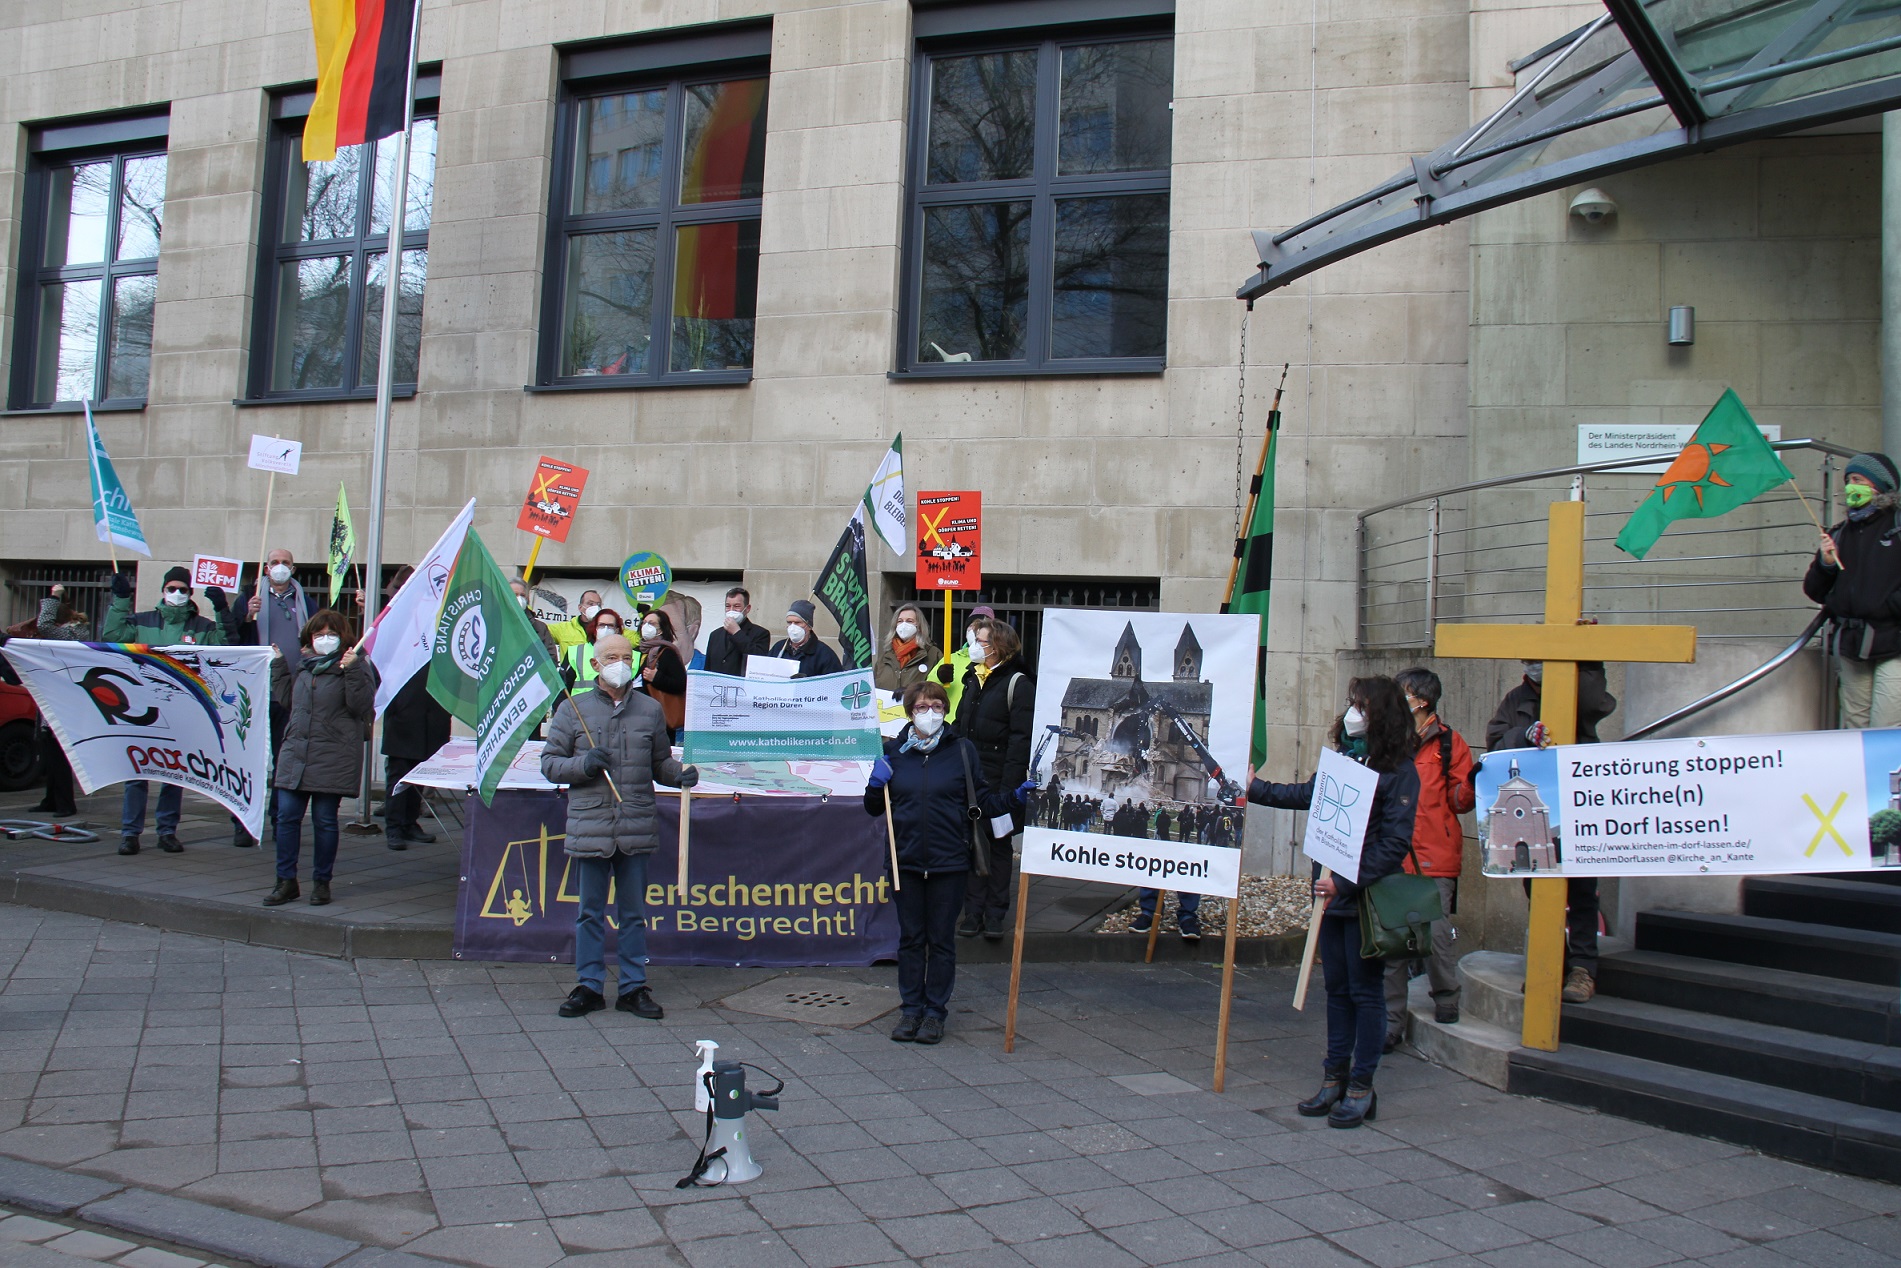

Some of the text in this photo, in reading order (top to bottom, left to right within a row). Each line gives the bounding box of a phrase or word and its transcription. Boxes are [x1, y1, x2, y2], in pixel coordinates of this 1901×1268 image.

[1605, 432, 1676, 441] Ministerpräsident
[884, 501, 906, 528] BLEIBE
[197, 572, 236, 587] SKFM
[627, 573, 665, 588] RETTEN!
[630, 567, 660, 579] KLIMA
[753, 695, 802, 703] Katholikenrat
[728, 736, 857, 746] www.katholikenrat-dn.de
[1571, 750, 1783, 777] Zerstörung stoppen!
[126, 745, 253, 805] pax christi
[142, 768, 184, 781] internationale
[185, 773, 214, 792] katholische
[1312, 771, 1327, 819] Diözesanrat
[1573, 784, 1704, 807] Die Kirche(n)
[1575, 814, 1729, 836] im Dorf lassen!
[1324, 831, 1348, 849] Katholiken
[1575, 839, 1751, 853] https://www.kirchen-im-dorf-lassen.de/
[1051, 843, 1209, 878] Kohle stoppen!
[1575, 852, 1754, 864] KirchenImDorfLassen @Kirche_an_Kante
[607, 873, 890, 906] enschenrecht
[677, 908, 856, 941] Bergrecht!
